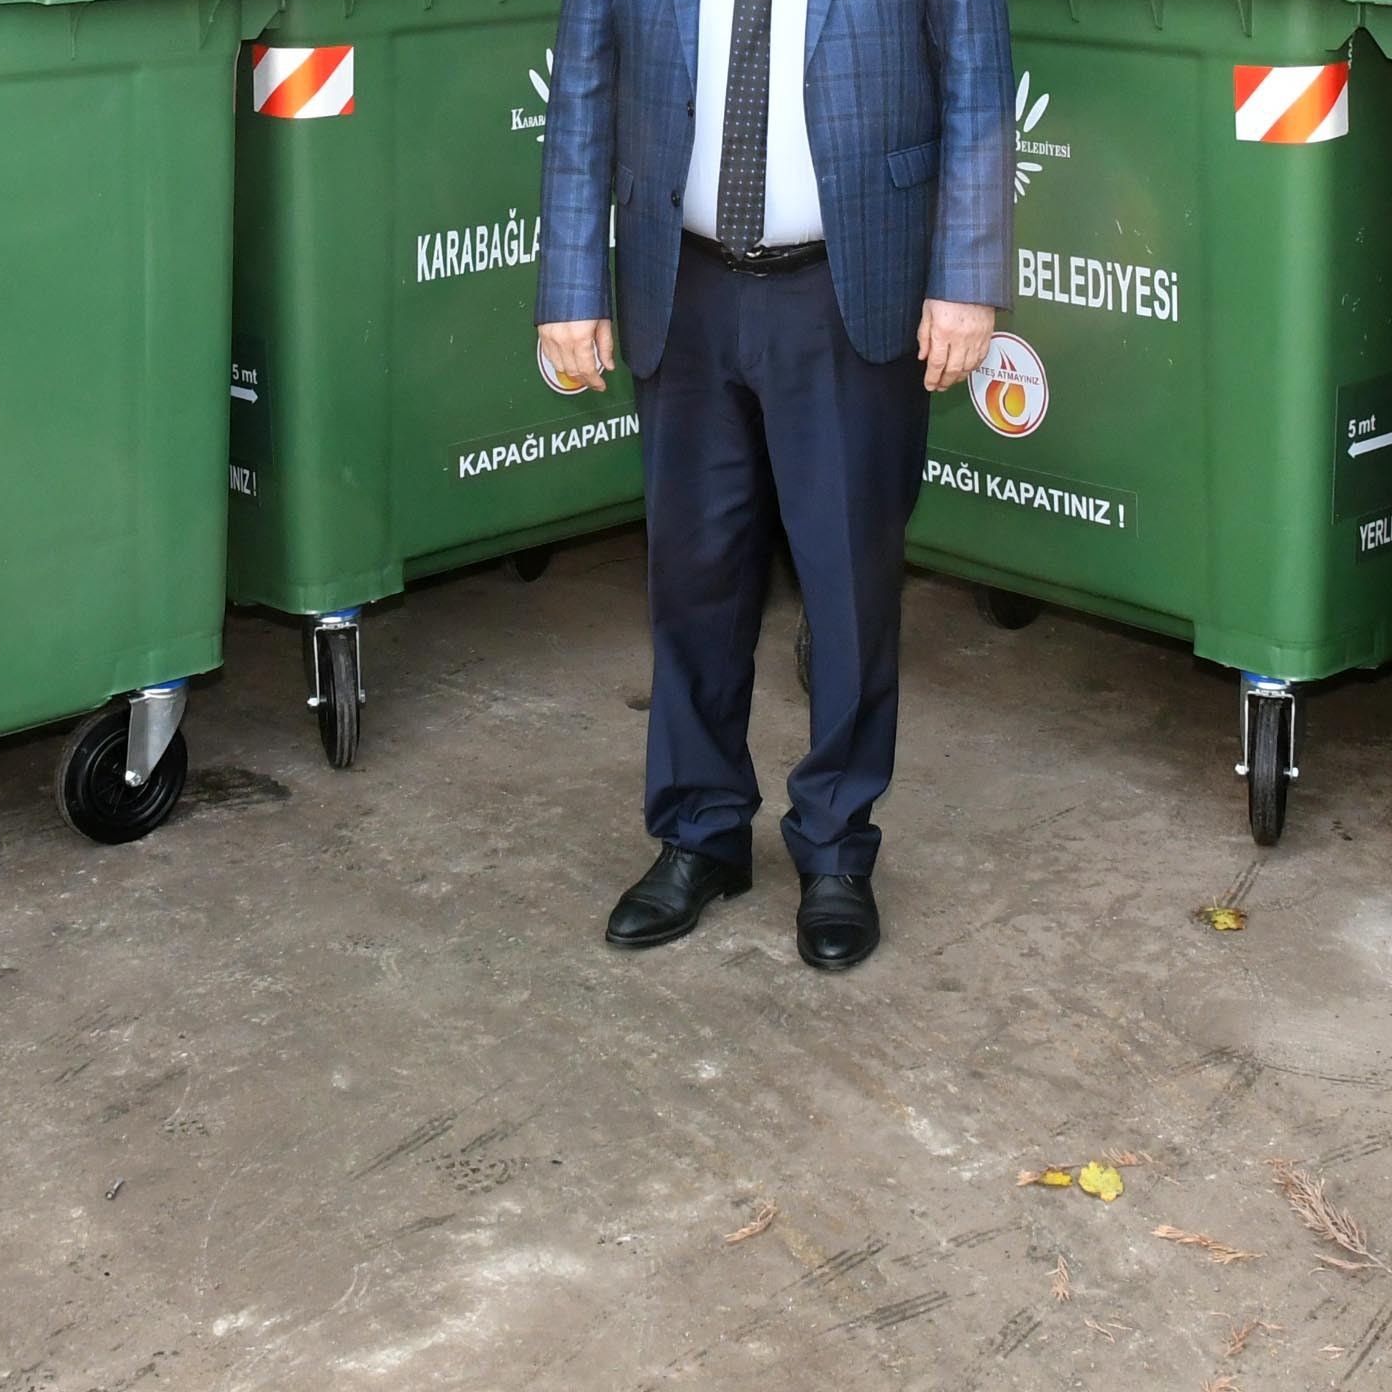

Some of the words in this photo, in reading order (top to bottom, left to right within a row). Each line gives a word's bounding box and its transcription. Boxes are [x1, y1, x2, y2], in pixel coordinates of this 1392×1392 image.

[232, 363, 239, 381] 5
[241, 368, 258, 385] mt
[1348, 419, 1357, 439] 5
[1358, 414, 1376, 436] mt
[459, 433, 545, 478] KAPAĞI
[986, 474, 1111, 525] KAPATINIZ
